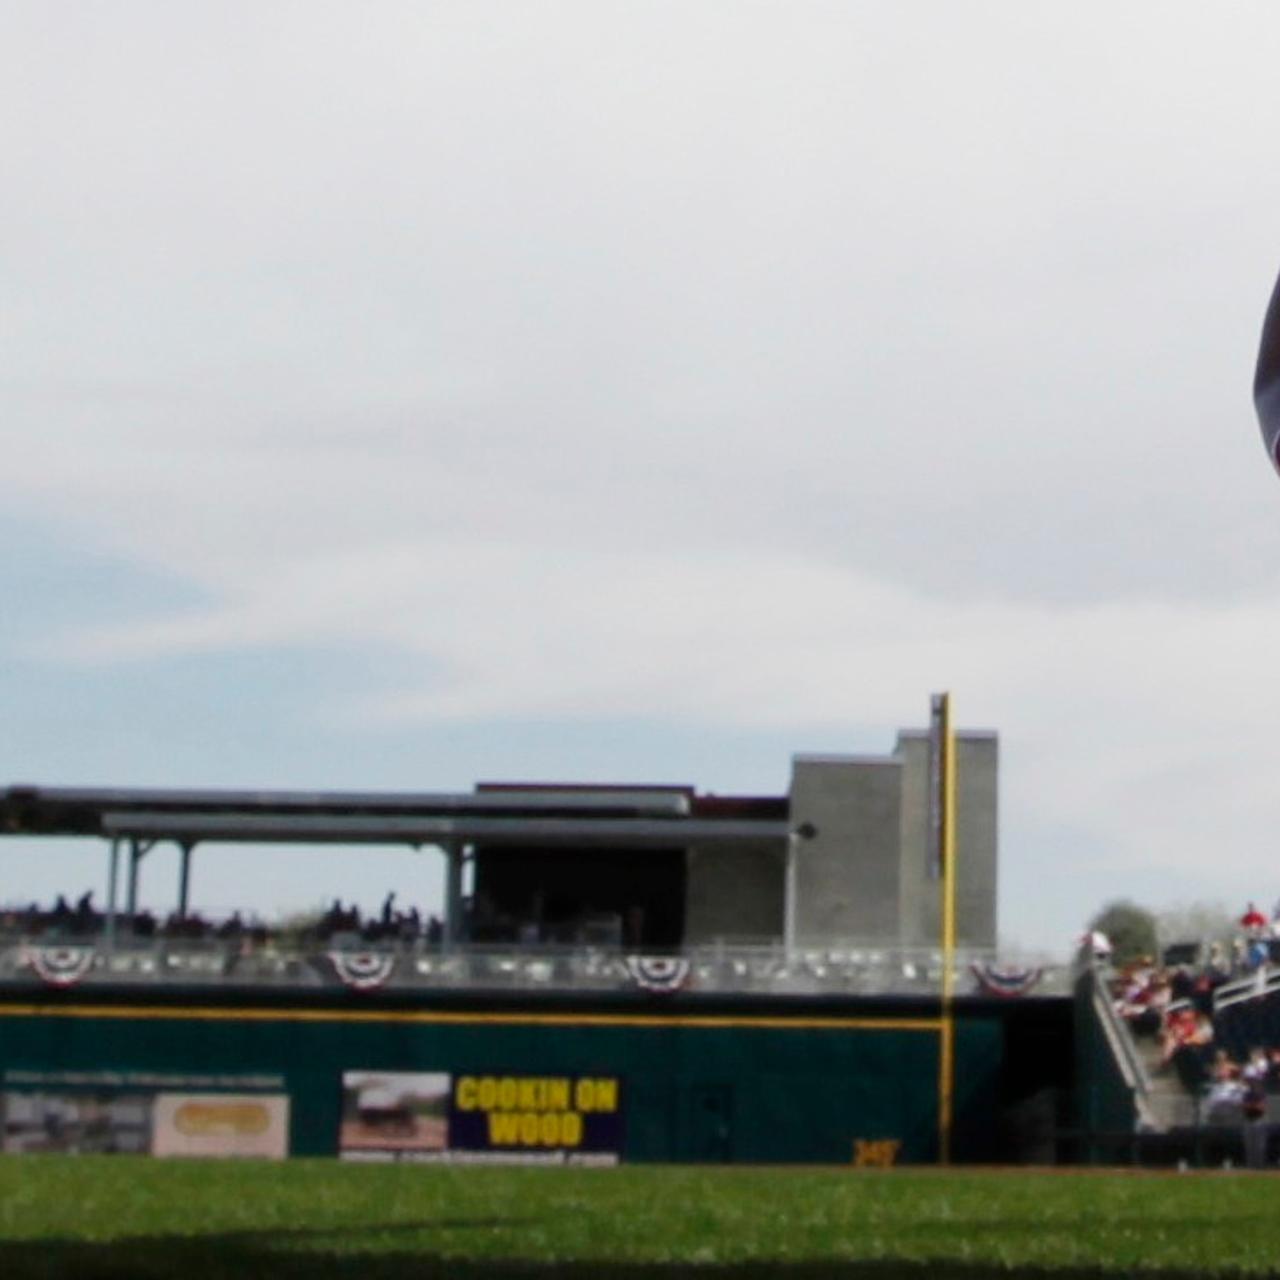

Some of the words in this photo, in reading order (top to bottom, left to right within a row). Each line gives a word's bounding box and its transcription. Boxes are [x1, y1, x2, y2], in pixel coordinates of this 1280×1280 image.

[456, 1075, 570, 1111] COOKIN
[575, 1077, 618, 1112] ON
[488, 1112, 583, 1146] WOOD
